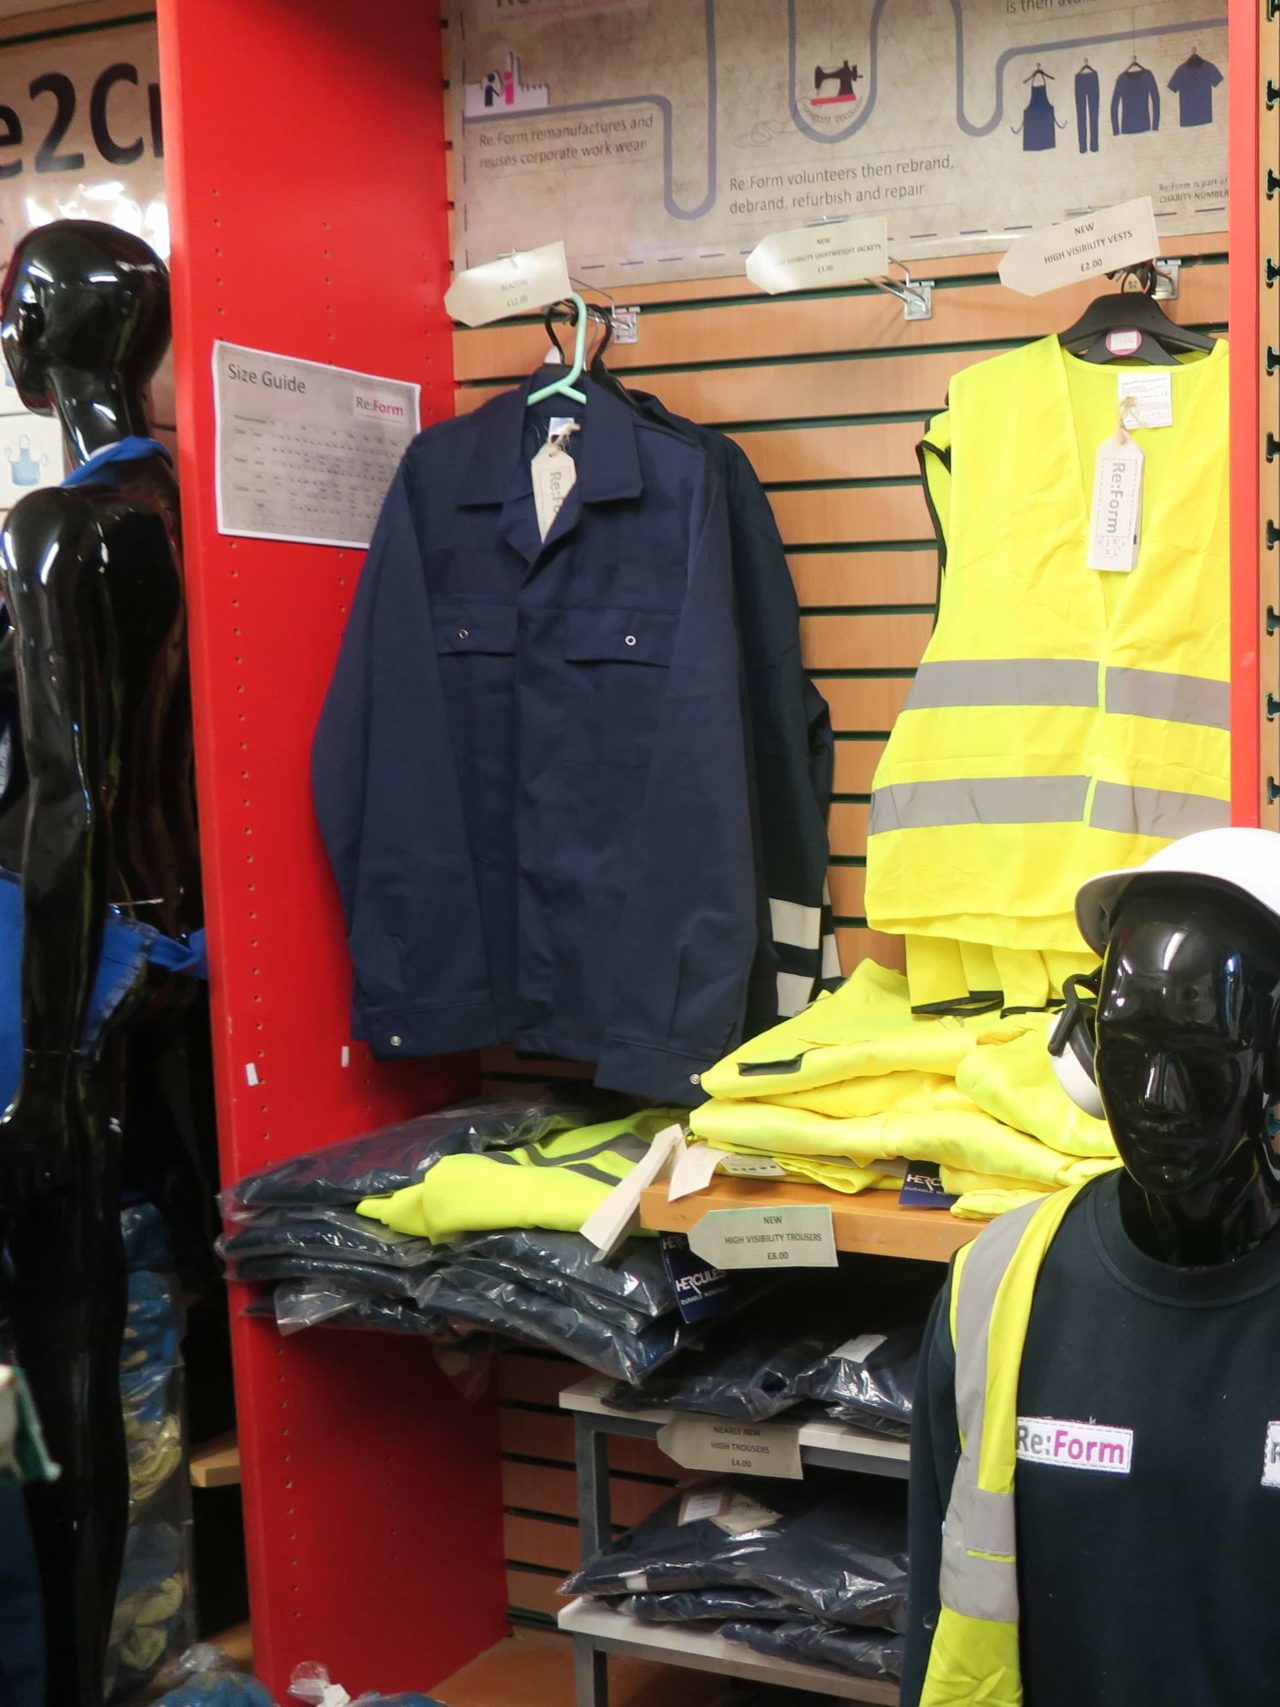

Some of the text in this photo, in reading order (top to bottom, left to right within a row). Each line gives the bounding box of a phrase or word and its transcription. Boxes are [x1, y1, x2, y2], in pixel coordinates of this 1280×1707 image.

[531, 117, 627, 141] remanufactures
[630, 114, 654, 129] and
[480, 139, 648, 169] reuses corporate work wear
[787, 167, 857, 185] volunteers
[861, 162, 892, 178] then
[896, 153, 955, 174] rebrand,
[730, 182, 925, 215] debrand, refurbish and repair
[1074, 222, 1095, 236] NEW
[1043, 229, 1134, 265] HIGH VISIBILITY VESTS
[1080, 258, 1103, 273] £2.00
[228, 363, 306, 394] Size Guide
[355, 396, 404, 417] Re:Form
[1106, 462, 1126, 534] Re:Form
[763, 1216, 783, 1225] NEW
[724, 1233, 823, 1244] HIGH VISIBILITY TROUSERS
[767, 1251, 789, 1260] £8.00
[675, 1268, 727, 1295] HERCULES
[713, 1425, 741, 1436] NEARLY
[710, 1441, 770, 1455] HIGH TROUSERS
[1017, 1424, 1126, 1465] Re:Form
